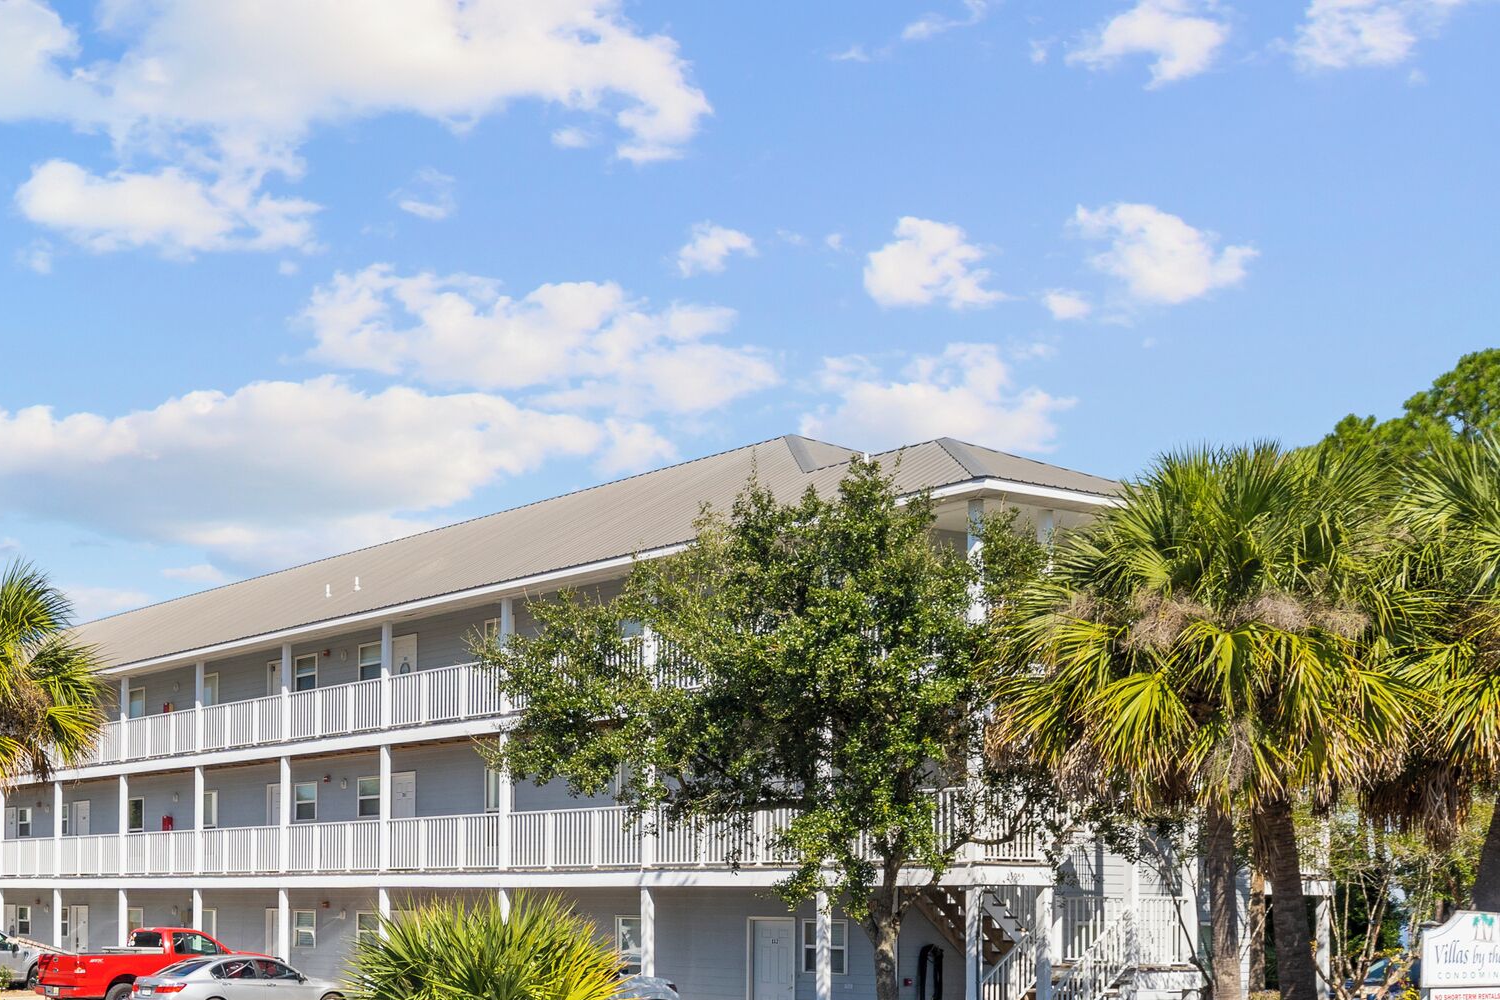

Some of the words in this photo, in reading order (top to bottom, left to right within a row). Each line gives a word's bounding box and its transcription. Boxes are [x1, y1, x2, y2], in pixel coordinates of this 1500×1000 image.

[1435, 939, 1470, 964] Villas
[1472, 944, 1486, 971] by
[1444, 993, 1477, 1000] SHORT-TERM
